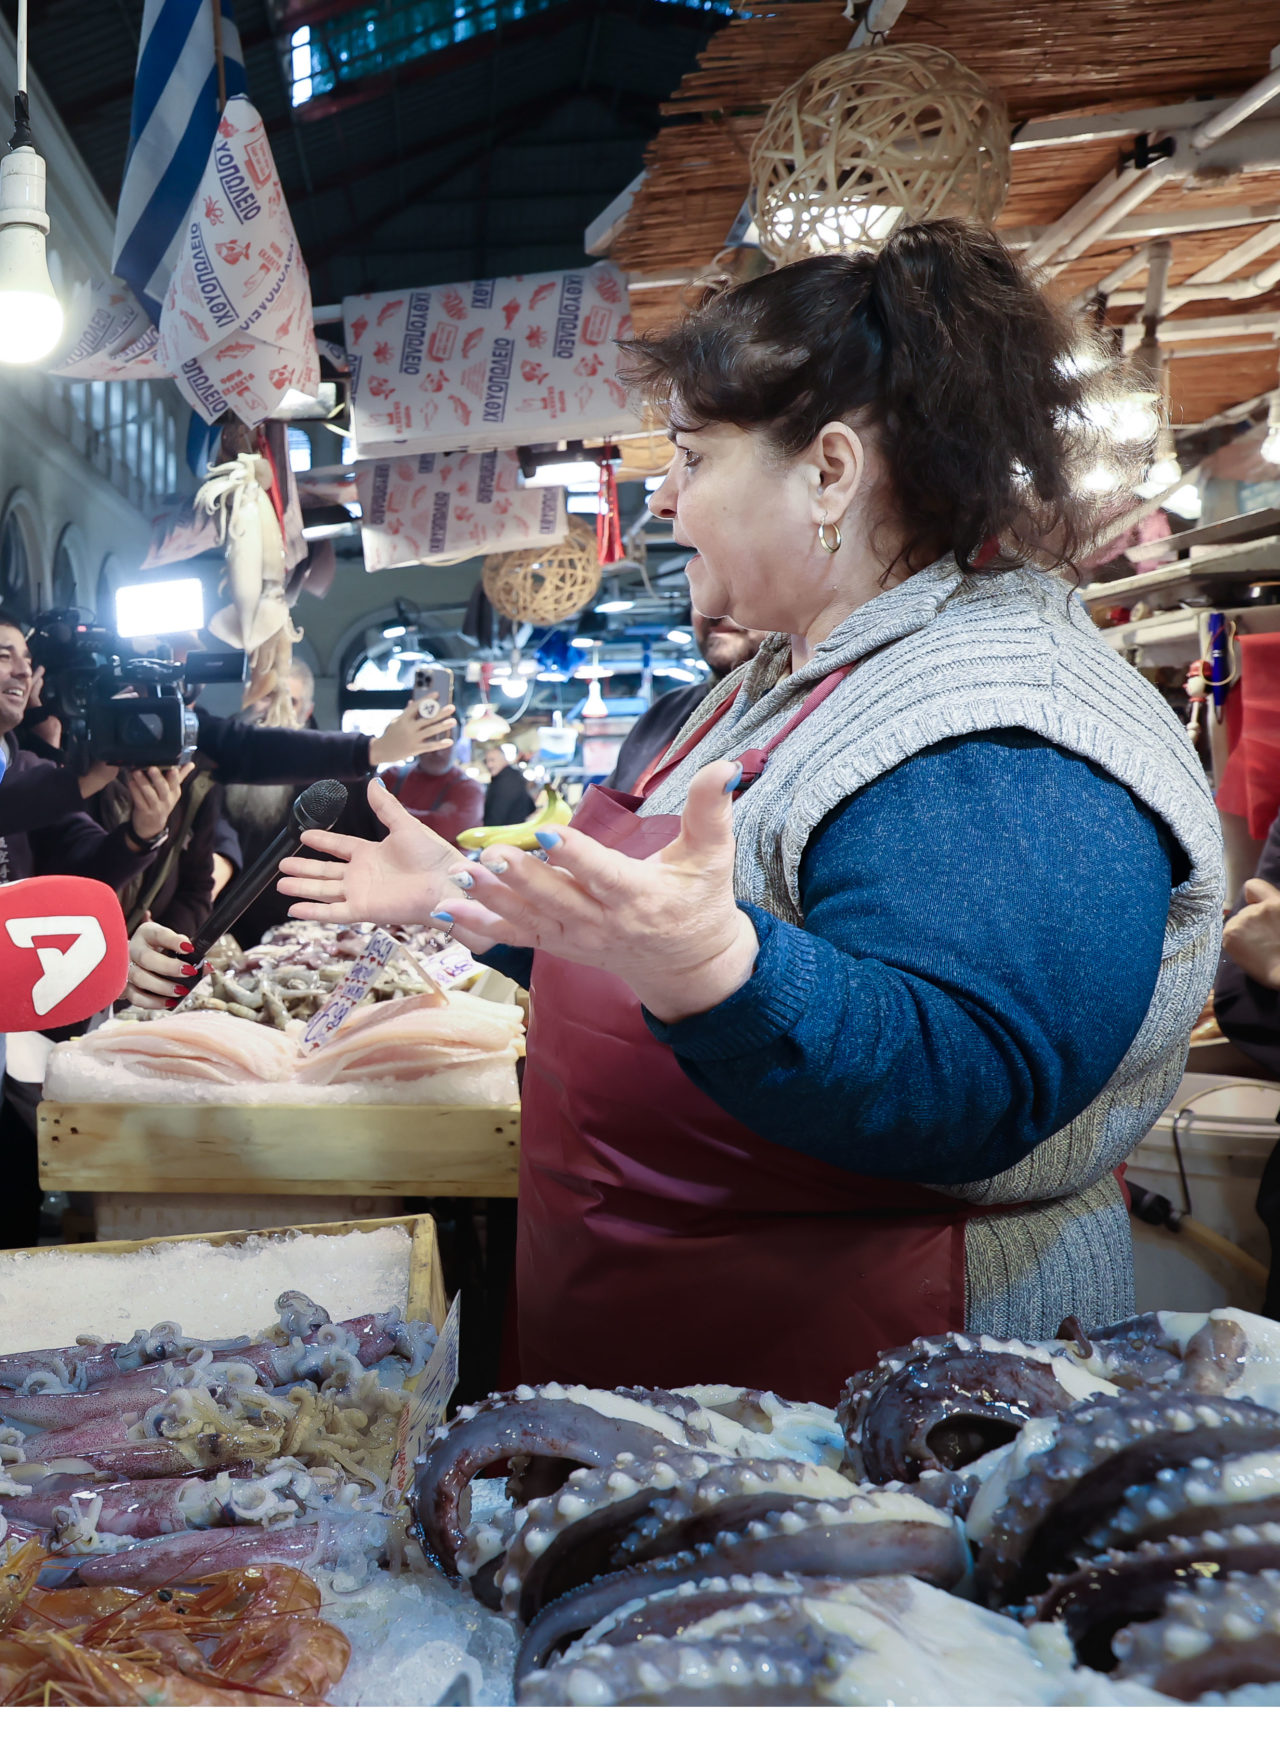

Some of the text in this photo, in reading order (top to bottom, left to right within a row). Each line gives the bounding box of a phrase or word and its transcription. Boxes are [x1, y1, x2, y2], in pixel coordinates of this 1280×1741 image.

[190, 222, 239, 329] ΙΧΘΥΟΠΩΛΕΙΟ
[553, 274, 584, 359] ΙΧΘΥΟΠΩΛΕΙΟ
[399, 292, 431, 376] ΙΧΘΥΟΠΩΛΕΙΟ
[483, 337, 515, 423] ΙΧΘΥΟΠΩΛΕΙΟ
